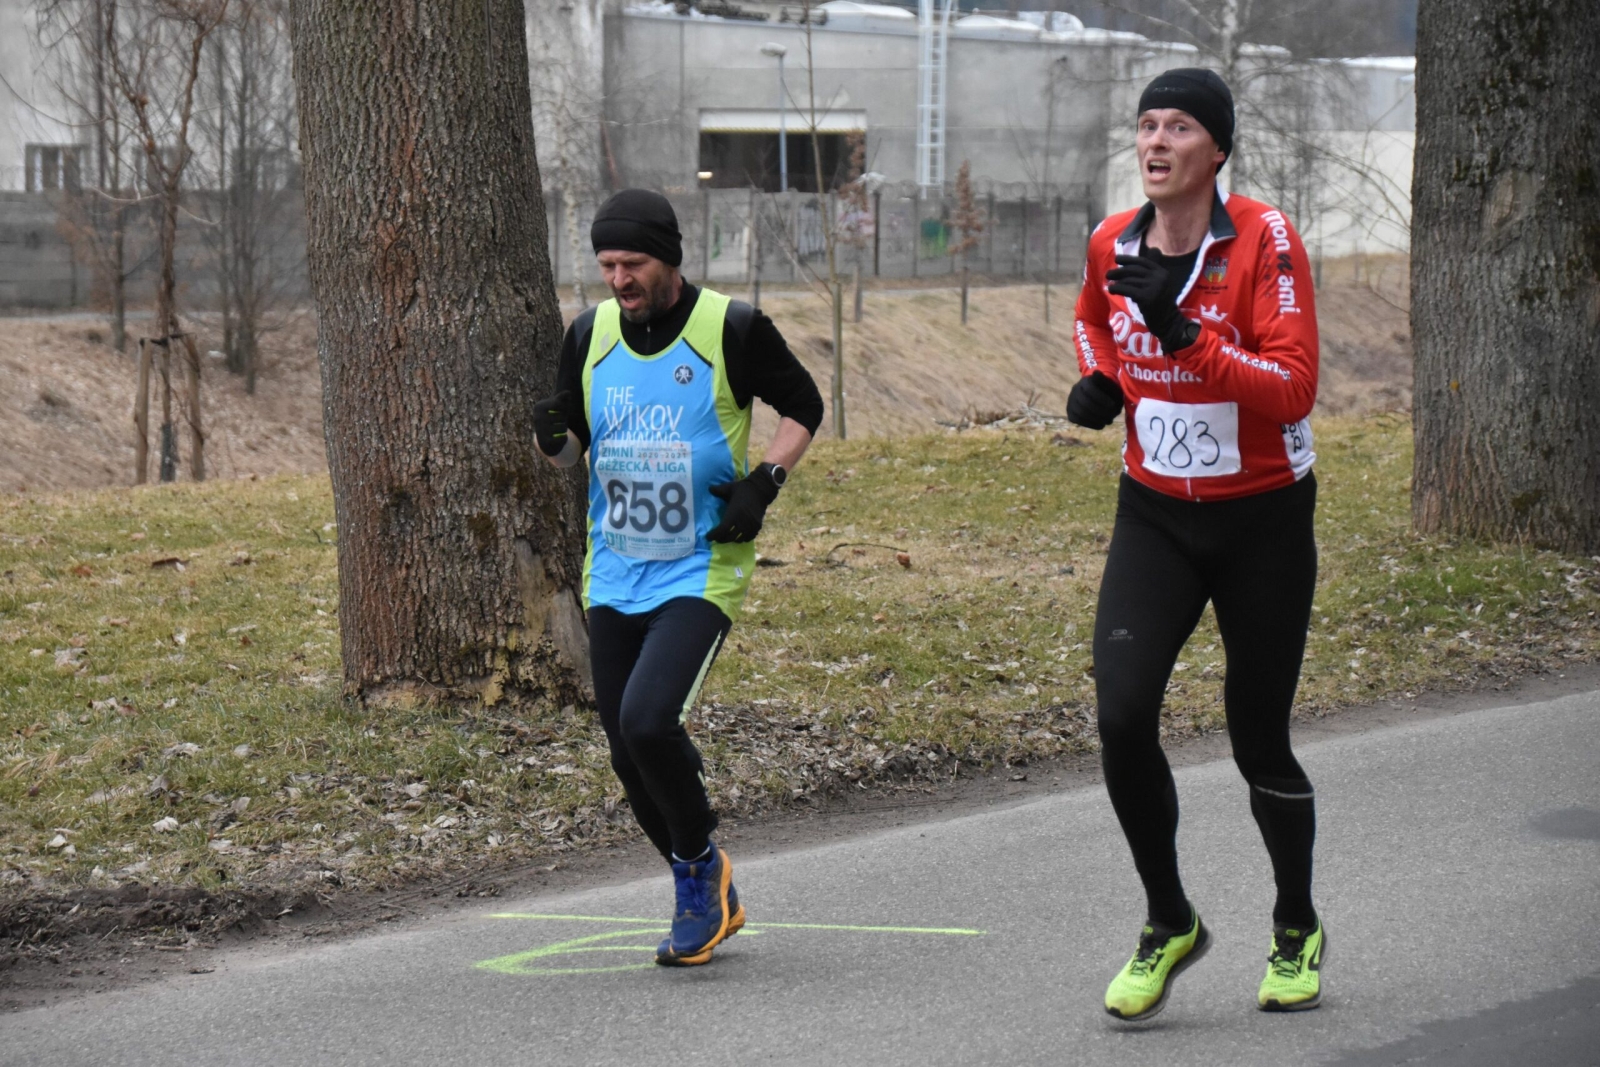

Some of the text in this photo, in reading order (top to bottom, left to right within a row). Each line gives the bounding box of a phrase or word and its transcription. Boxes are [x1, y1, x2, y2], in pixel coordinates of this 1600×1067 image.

[605, 385, 635, 405] THE
[603, 404, 684, 432] WIKOV
[1149, 415, 1221, 468] 283
[656, 461, 687, 473] LIGA
[607, 479, 689, 534] 658
